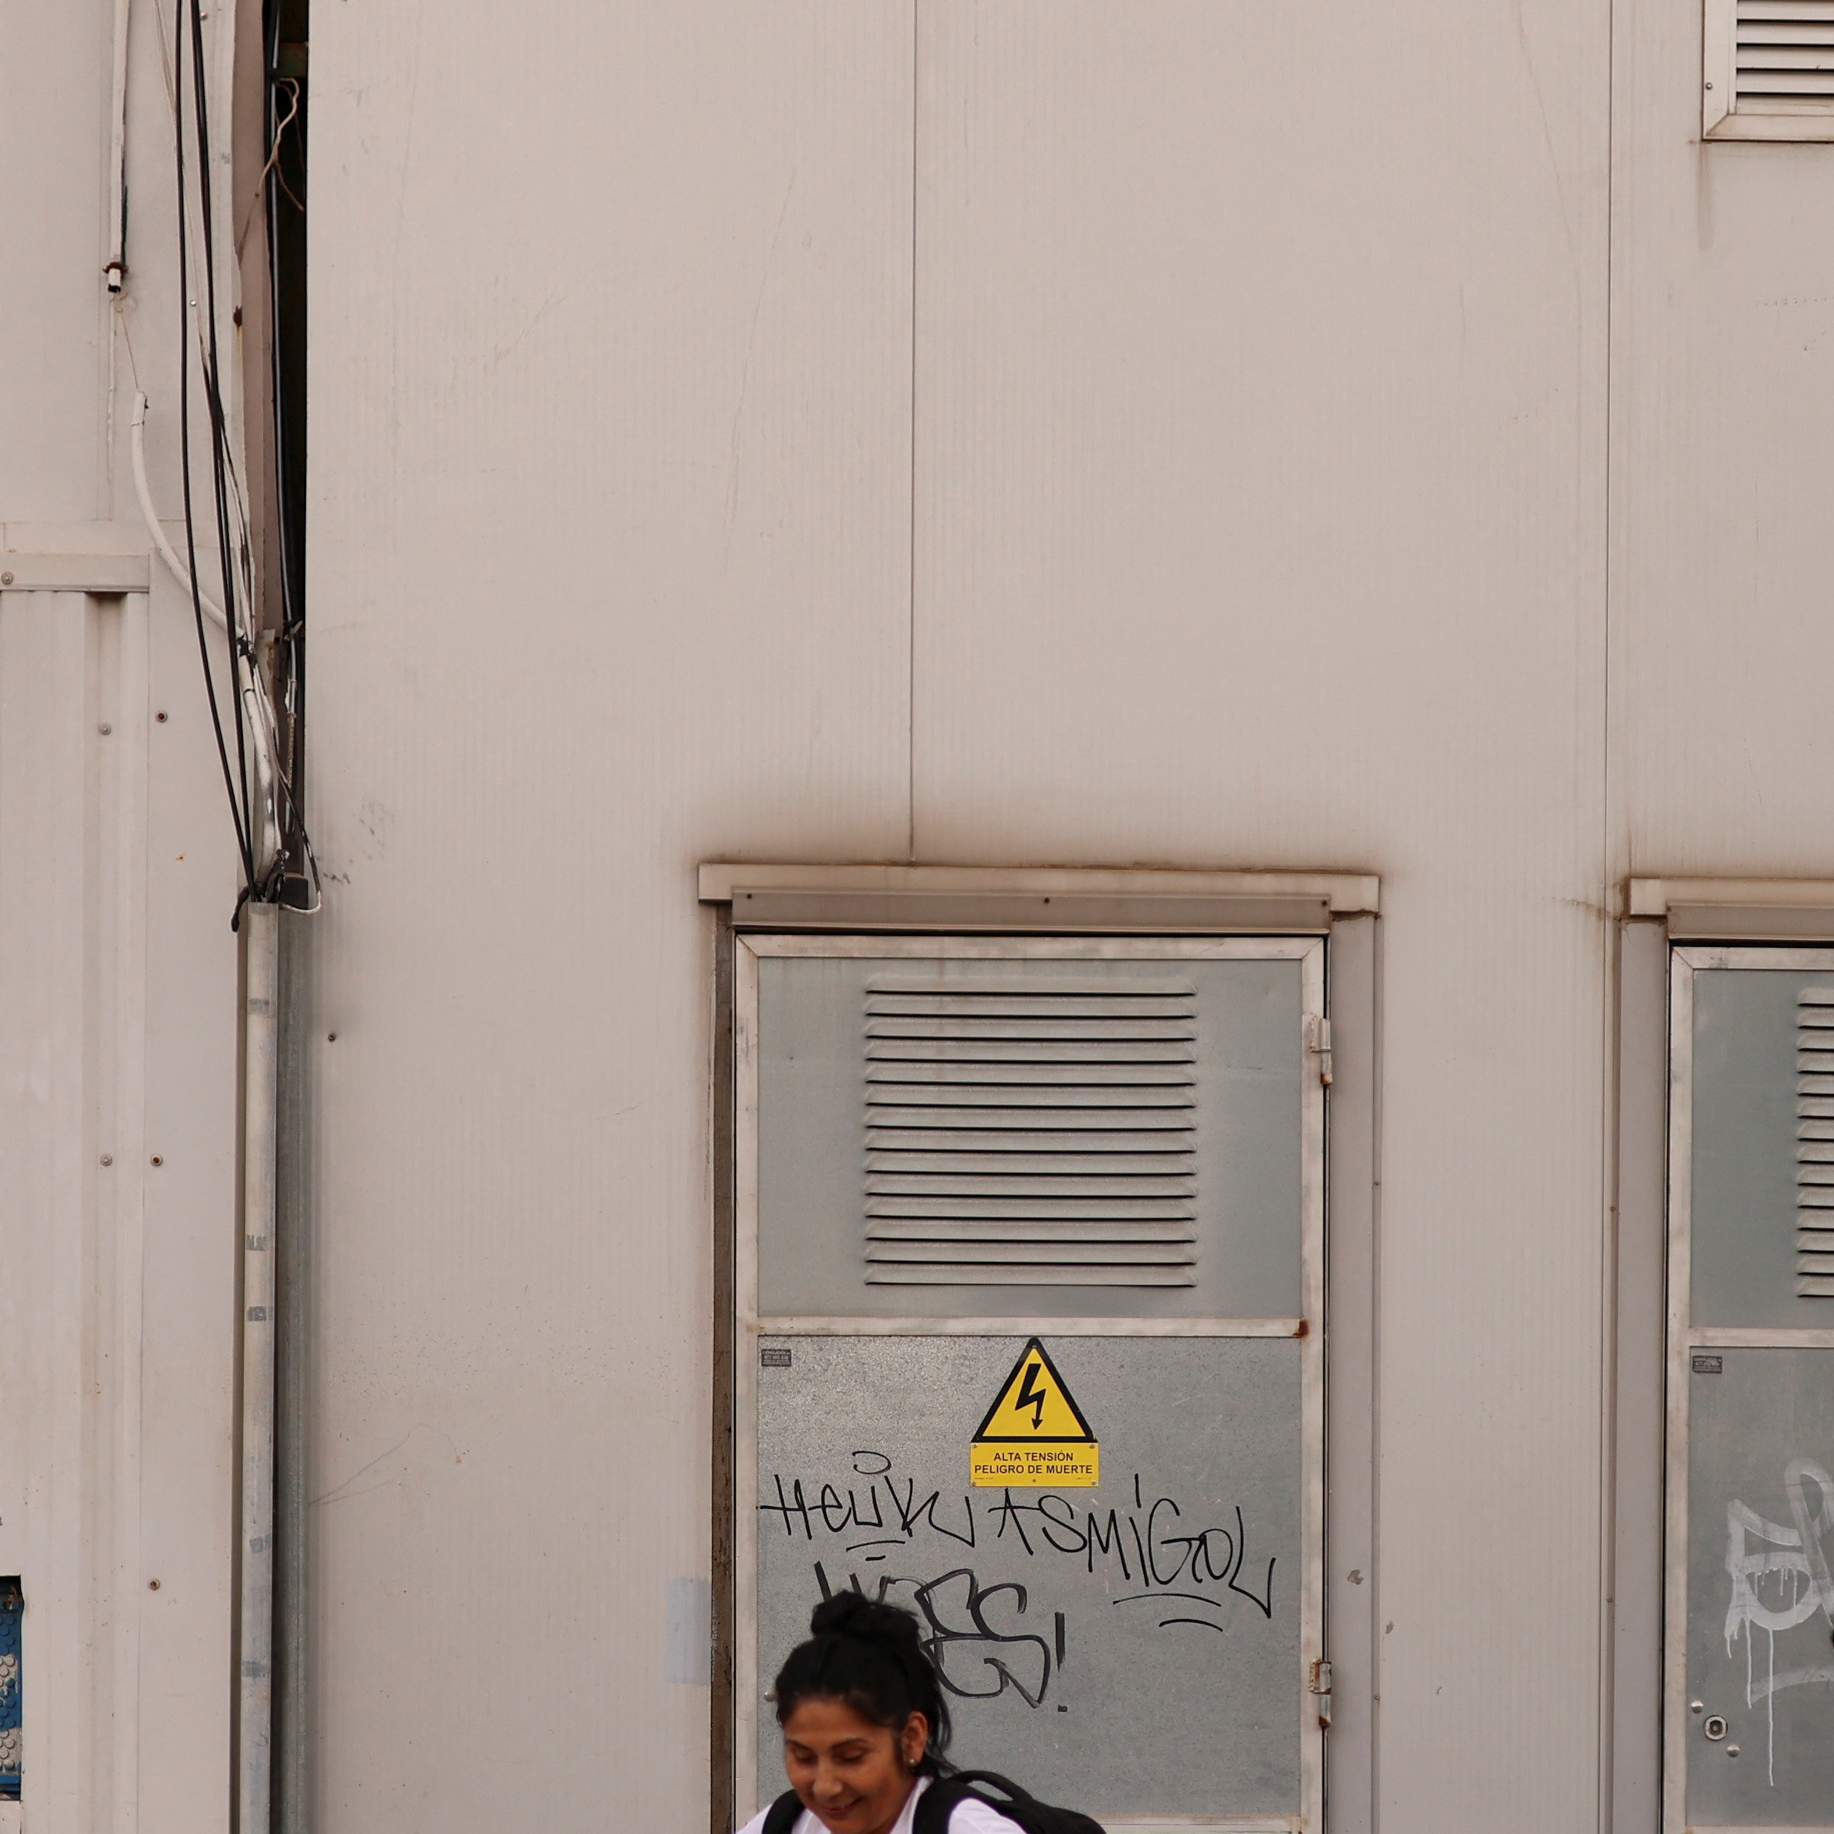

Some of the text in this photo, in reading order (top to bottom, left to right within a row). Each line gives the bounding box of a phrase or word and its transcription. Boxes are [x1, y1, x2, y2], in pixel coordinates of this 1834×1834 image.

[994, 1450, 1074, 1462] ALTA TENSIÓN
[974, 1465, 1093, 1474] PELIGRO DE MUERTE
